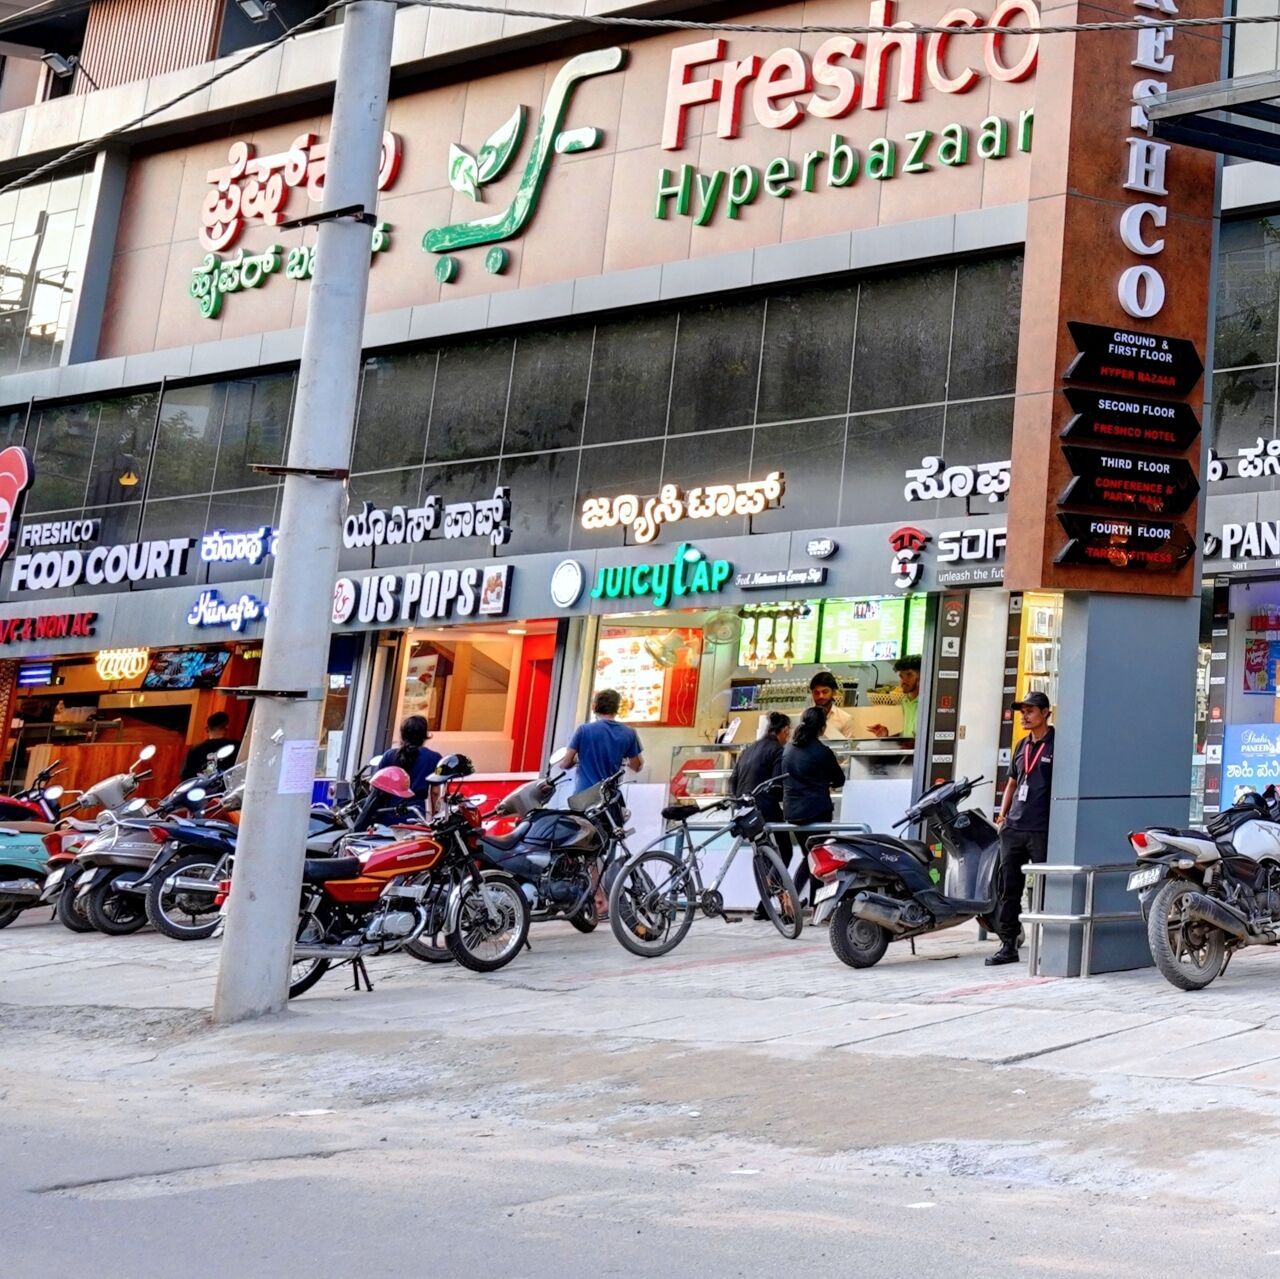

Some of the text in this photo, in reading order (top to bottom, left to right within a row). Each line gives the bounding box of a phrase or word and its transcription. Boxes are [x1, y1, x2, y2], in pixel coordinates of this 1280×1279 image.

[655, 107, 1035, 226] Hyperbazaar
[1113, 331, 1169, 350] GROUND &
[1108, 343, 1173, 363] FIRST FLOOR
[1100, 366, 1176, 386] HYPER BAZAAR
[1098, 399, 1176, 419] SECOND FLOOR
[1093, 422, 1176, 442] FRESHCO HOTEL
[1101, 456, 1170, 474] THIRD FLOOR
[1095, 478, 1163, 494] CONFERENCE
[21, 520, 94, 547] FRESHCO
[1090, 522, 1171, 539] FOURTH FLOOR
[11, 537, 191, 592] FOOD COURT
[1231, 561, 1248, 571] SOFT
[938, 569, 971, 583] unleash
[973, 567, 989, 580] the
[358, 567, 478, 623] US POPS
[36, 615, 70, 639] NON
[70, 612, 95, 637] AC
